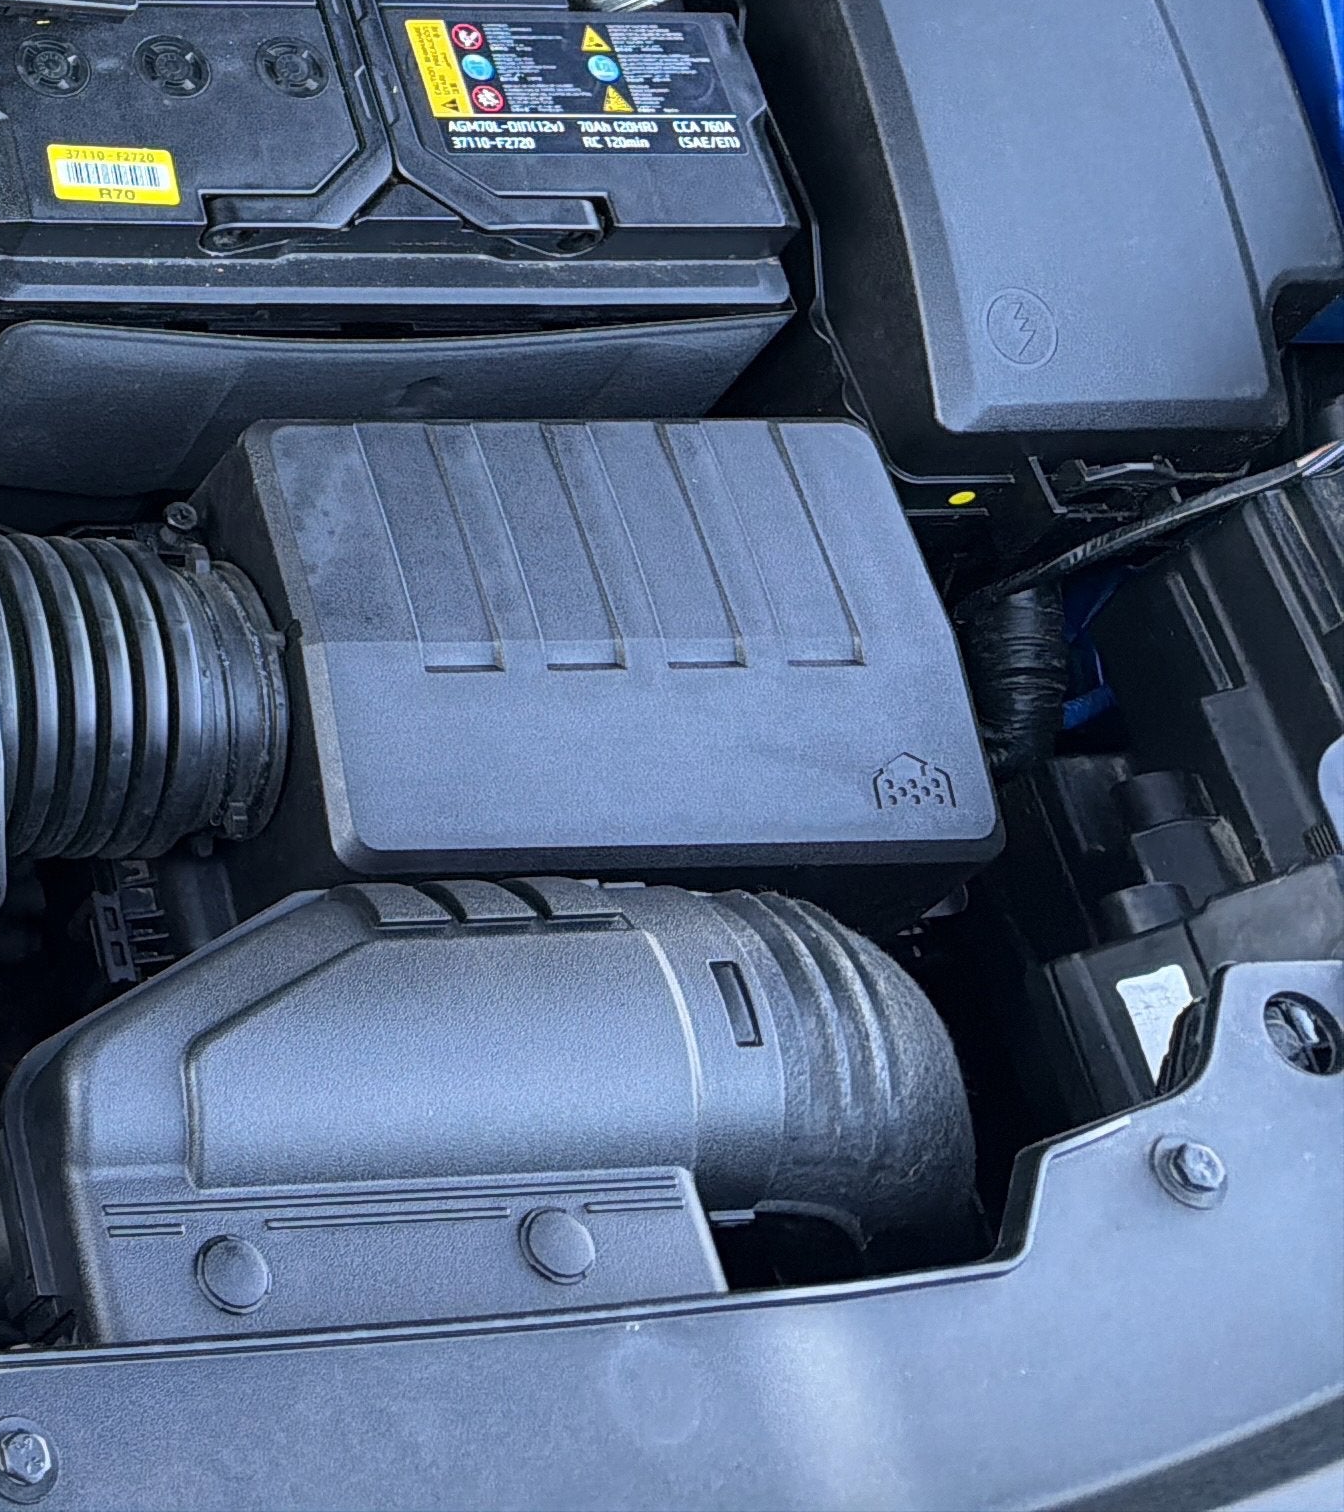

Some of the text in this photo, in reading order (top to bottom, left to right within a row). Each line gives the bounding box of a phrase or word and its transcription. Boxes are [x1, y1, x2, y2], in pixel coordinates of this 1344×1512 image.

[577, 120, 612, 133] 70Ah
[613, 120, 659, 133] (20HR)
[672, 120, 702, 133] CCA
[451, 136, 536, 149] 37110-F2720
[582, 136, 604, 149] RC
[605, 136, 650, 149] 120min
[98, 188, 136, 201] R70
